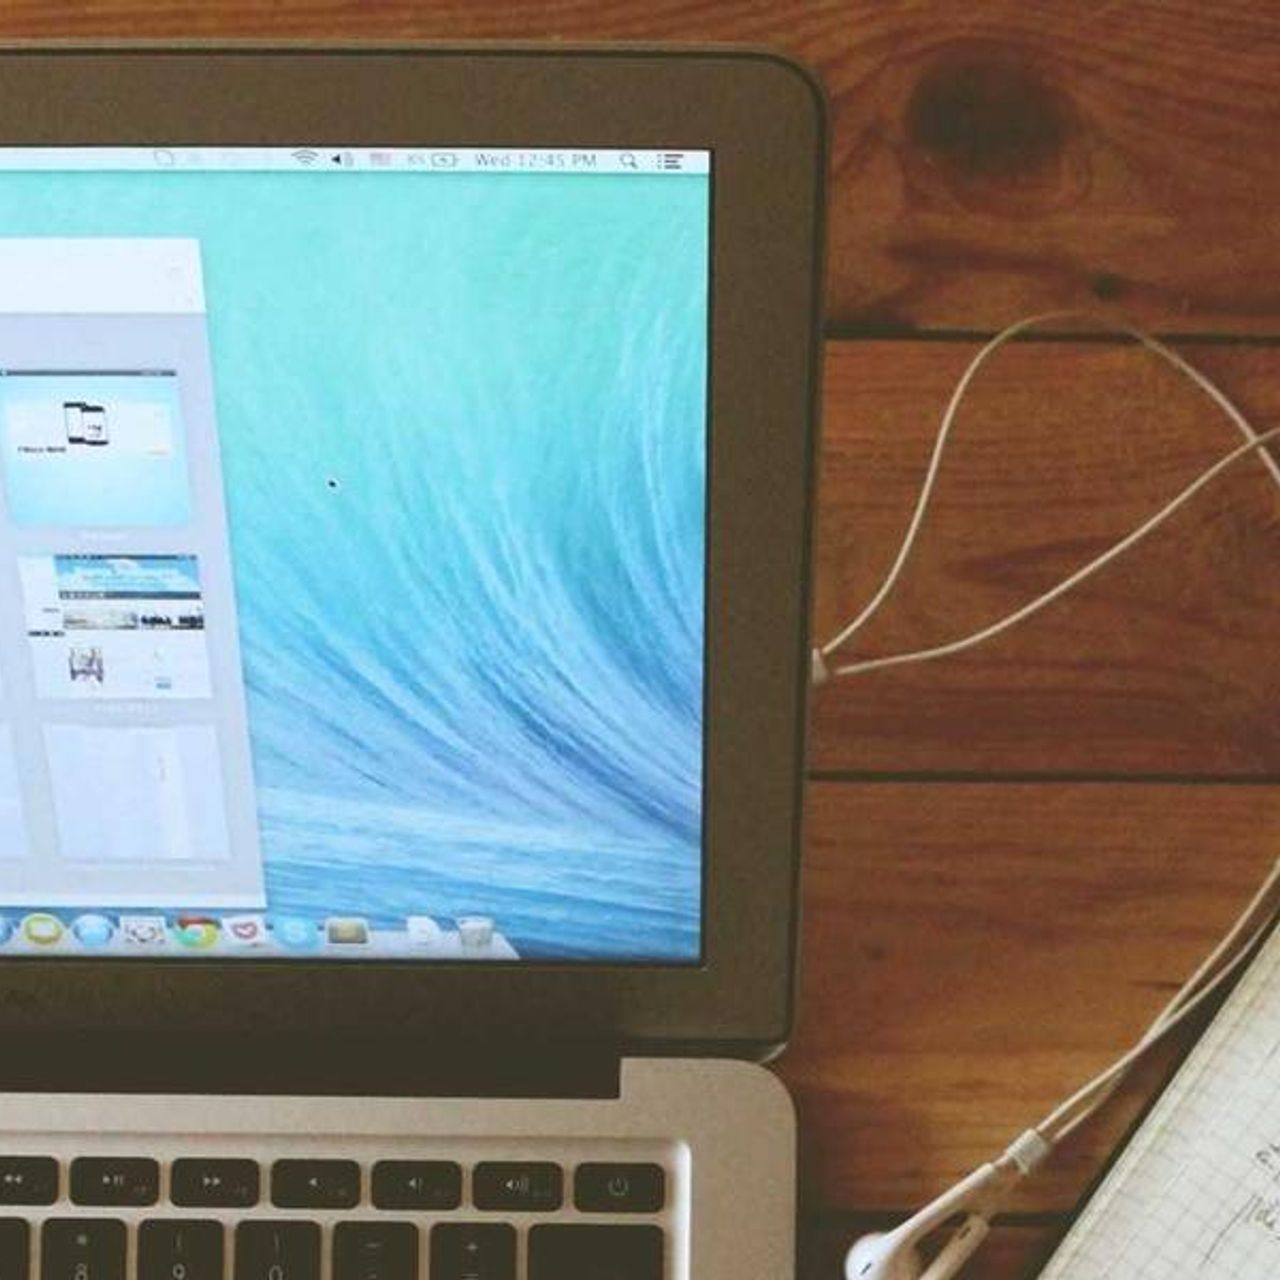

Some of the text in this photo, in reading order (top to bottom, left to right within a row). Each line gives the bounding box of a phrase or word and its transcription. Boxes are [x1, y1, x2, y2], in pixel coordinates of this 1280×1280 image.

[474, 151, 598, 169] Wed 12:45 PM
